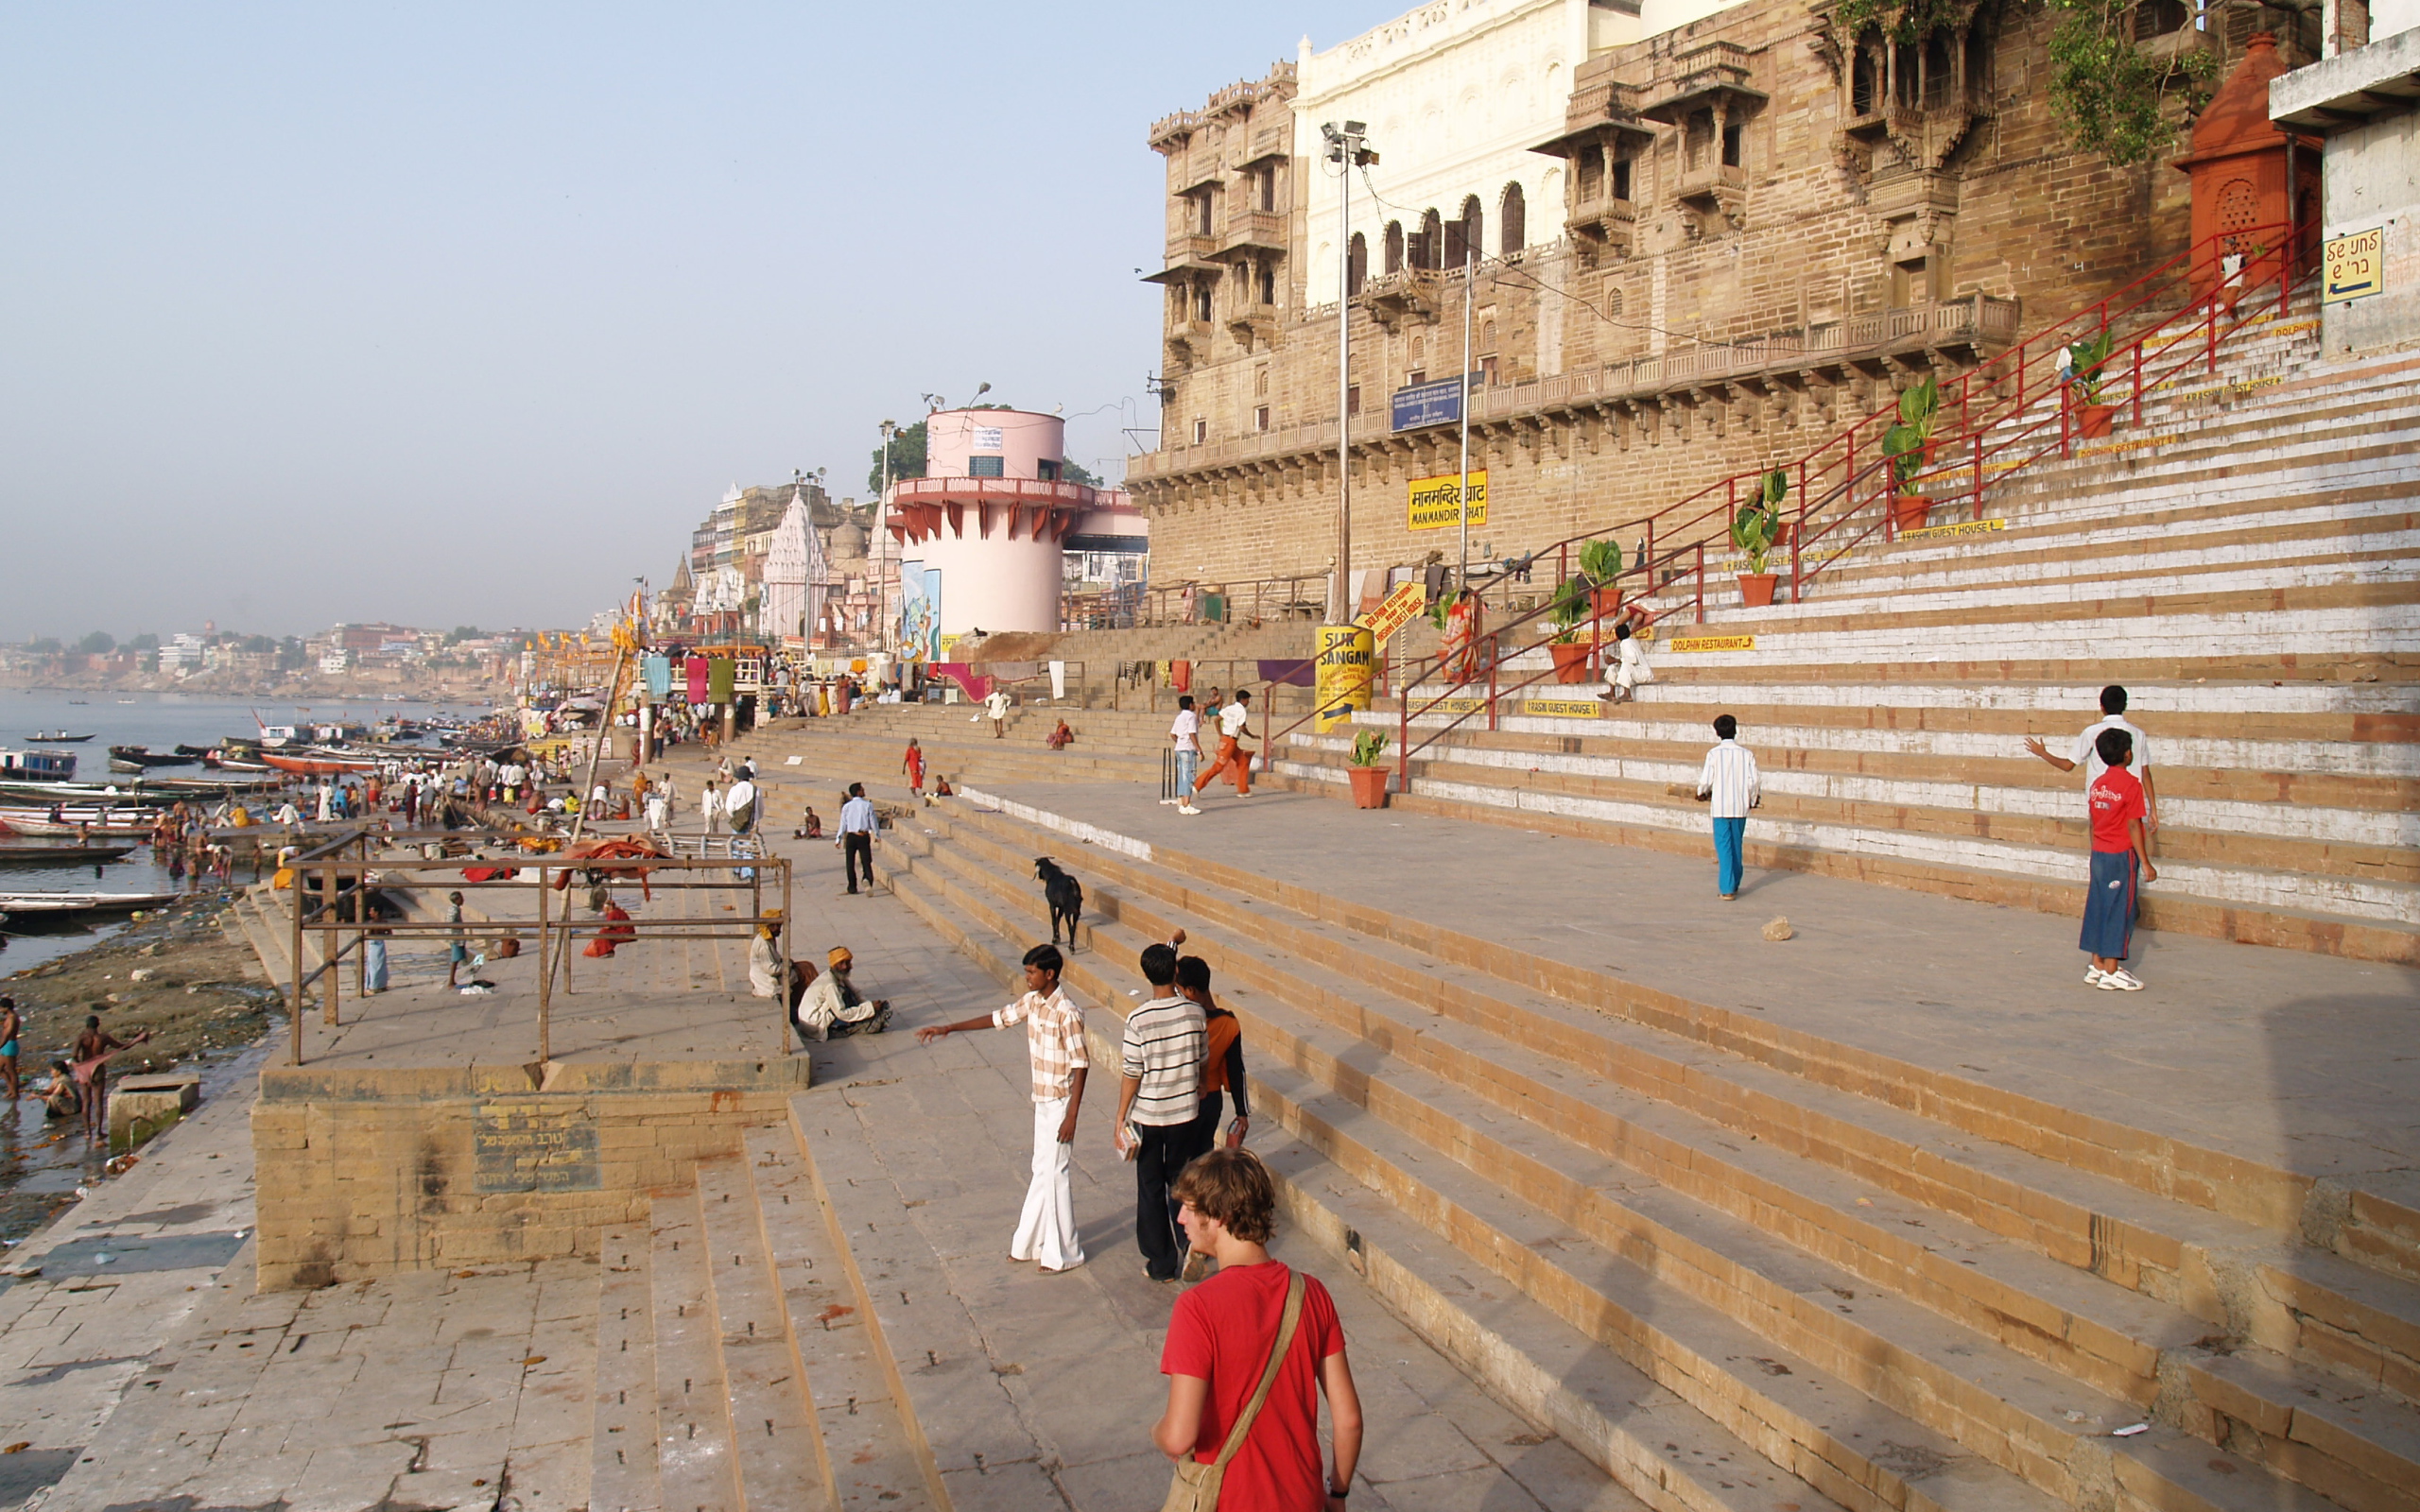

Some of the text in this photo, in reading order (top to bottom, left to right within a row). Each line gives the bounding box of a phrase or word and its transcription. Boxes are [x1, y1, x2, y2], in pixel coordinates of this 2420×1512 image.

[2275, 321, 2314, 337] DOLPHIN
[2223, 384, 2248, 396] GUEST
[2250, 379, 2275, 391] HOUSE
[2116, 438, 2165, 453] RESTAURANT
[1411, 507, 1460, 525] MANMANDIR
[1931, 527, 1956, 539] GUEST
[1958, 523, 1988, 535] HOUSE
[1788, 554, 1816, 565] HUSE
[1364, 582, 1414, 628] DOLPHIN RESTAURANT
[1392, 610, 1409, 627] GUEST
[1406, 596, 1425, 615] HOUSE
[1672, 638, 1743, 651] DOLPHIN RESTAURANT
[1321, 649, 1370, 666] SANGAM
[1450, 701, 1471, 711] HOUSE
[1547, 702, 1567, 713] GUEST
[1568, 703, 1591, 714] HOUSE
